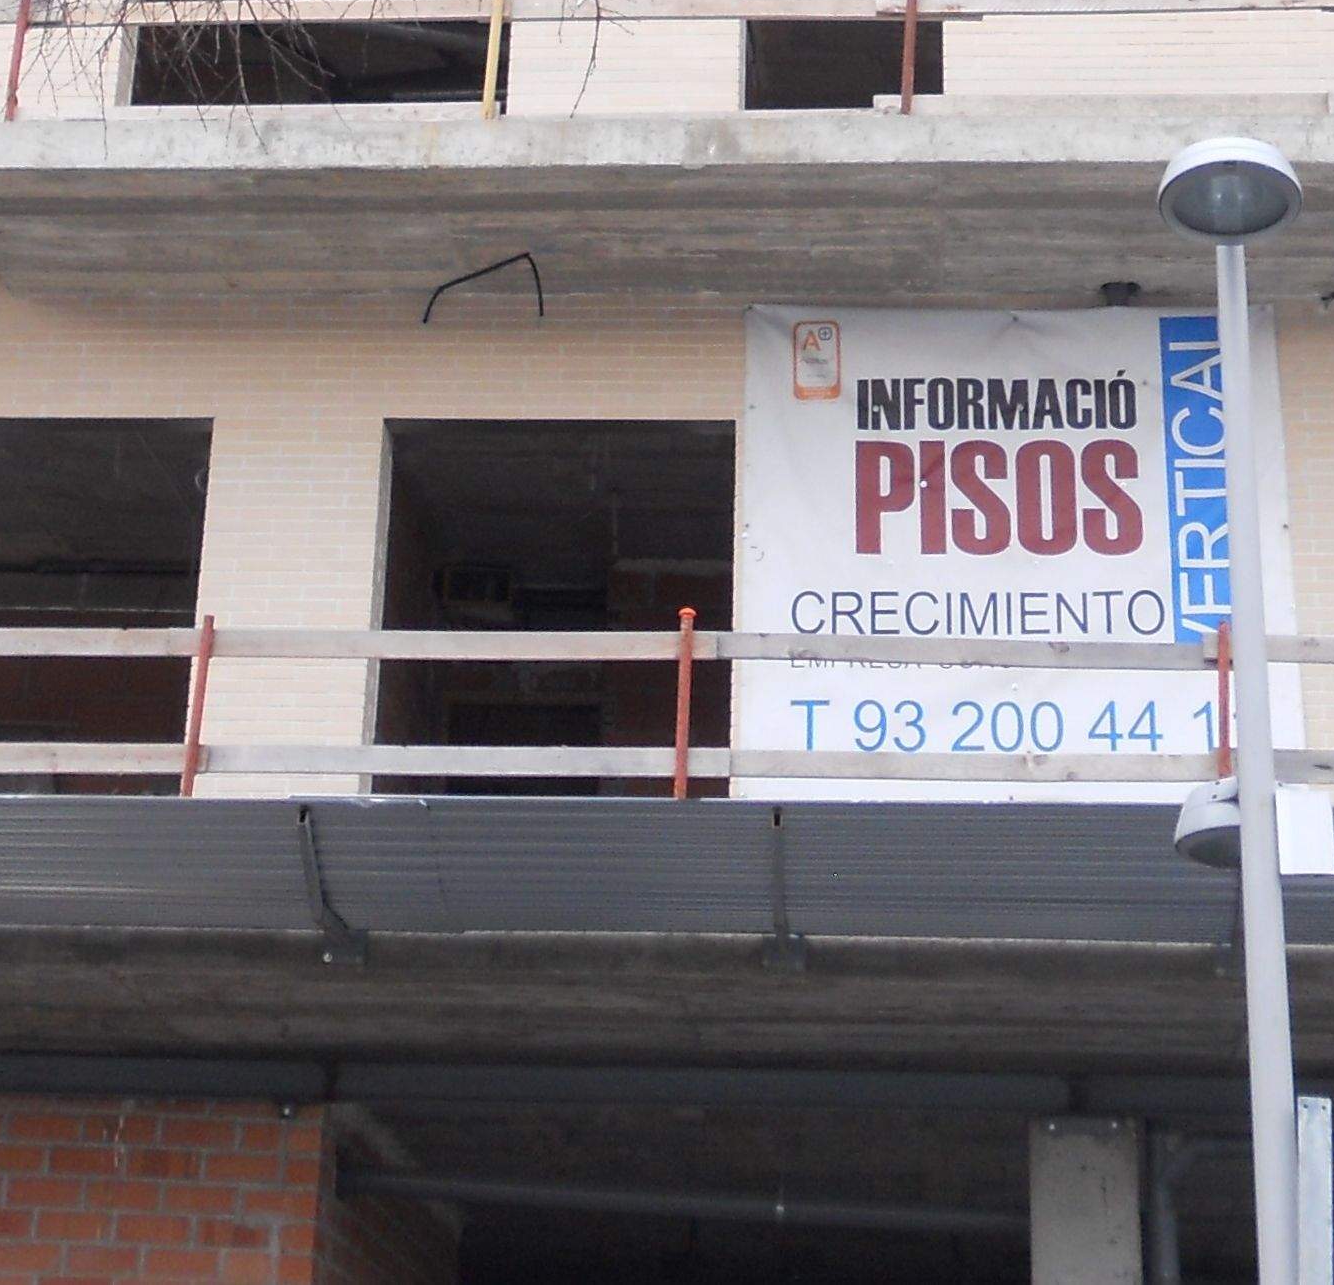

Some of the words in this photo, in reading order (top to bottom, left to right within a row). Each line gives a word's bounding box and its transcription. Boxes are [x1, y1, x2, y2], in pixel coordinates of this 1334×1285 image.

[857, 370, 1137, 431] INFORMACIÓ
[855, 439, 1144, 556] PISOS
[791, 590, 1165, 635] CRECIMIENTO
[790, 699, 830, 752] T
[854, 699, 926, 752] 93
[951, 700, 1064, 752] 200
[1088, 700, 1163, 752] 44
